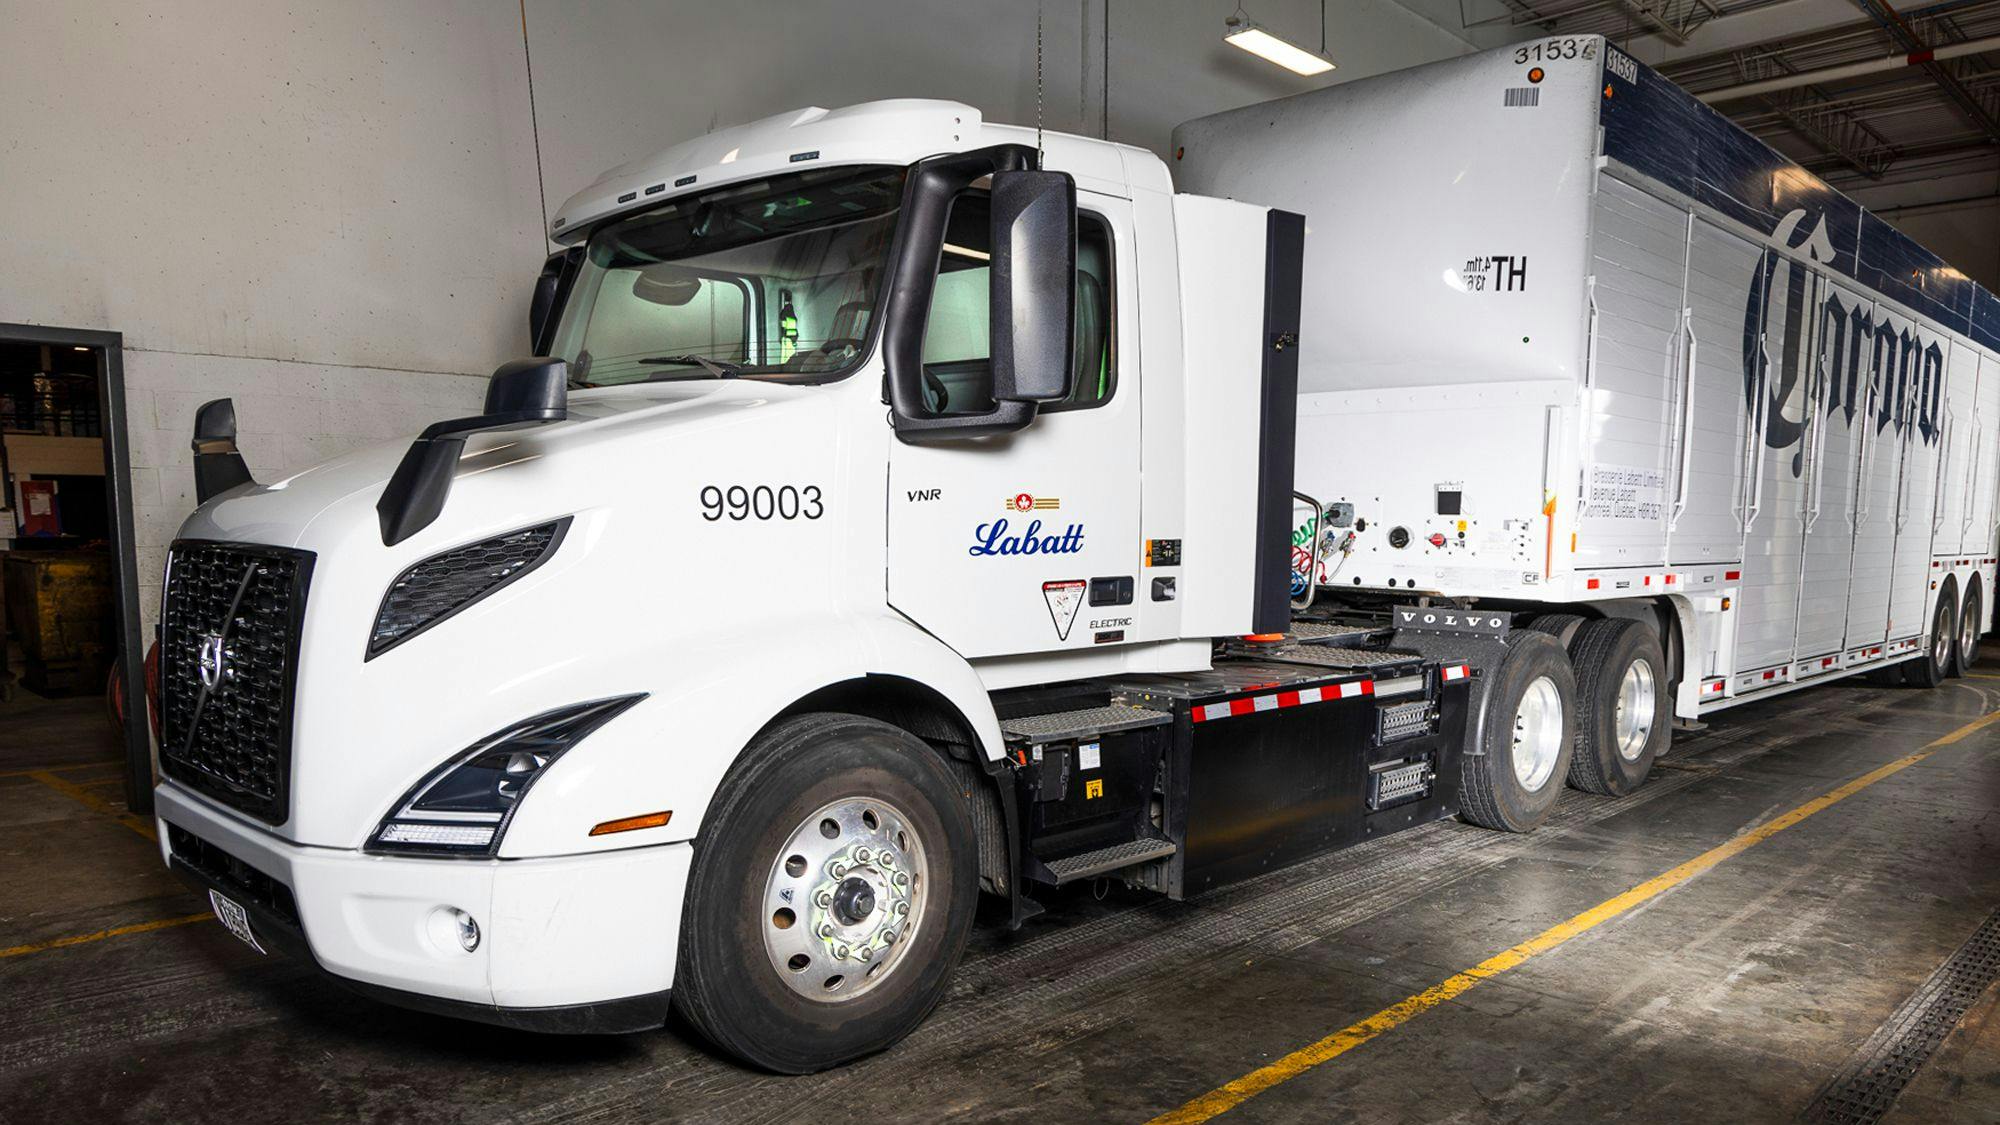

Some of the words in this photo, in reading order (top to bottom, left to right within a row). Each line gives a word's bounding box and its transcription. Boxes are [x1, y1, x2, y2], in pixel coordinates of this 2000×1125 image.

[1607, 47, 1637, 82] 31537
[1743, 208, 1943, 479] Corona
[700, 485, 824, 521] 99003
[907, 488, 942, 502] VNR
[968, 518, 1085, 556] Labatt
[1088, 617, 1133, 629] ELECTRIC
[1401, 612, 1502, 629] VOLVO
